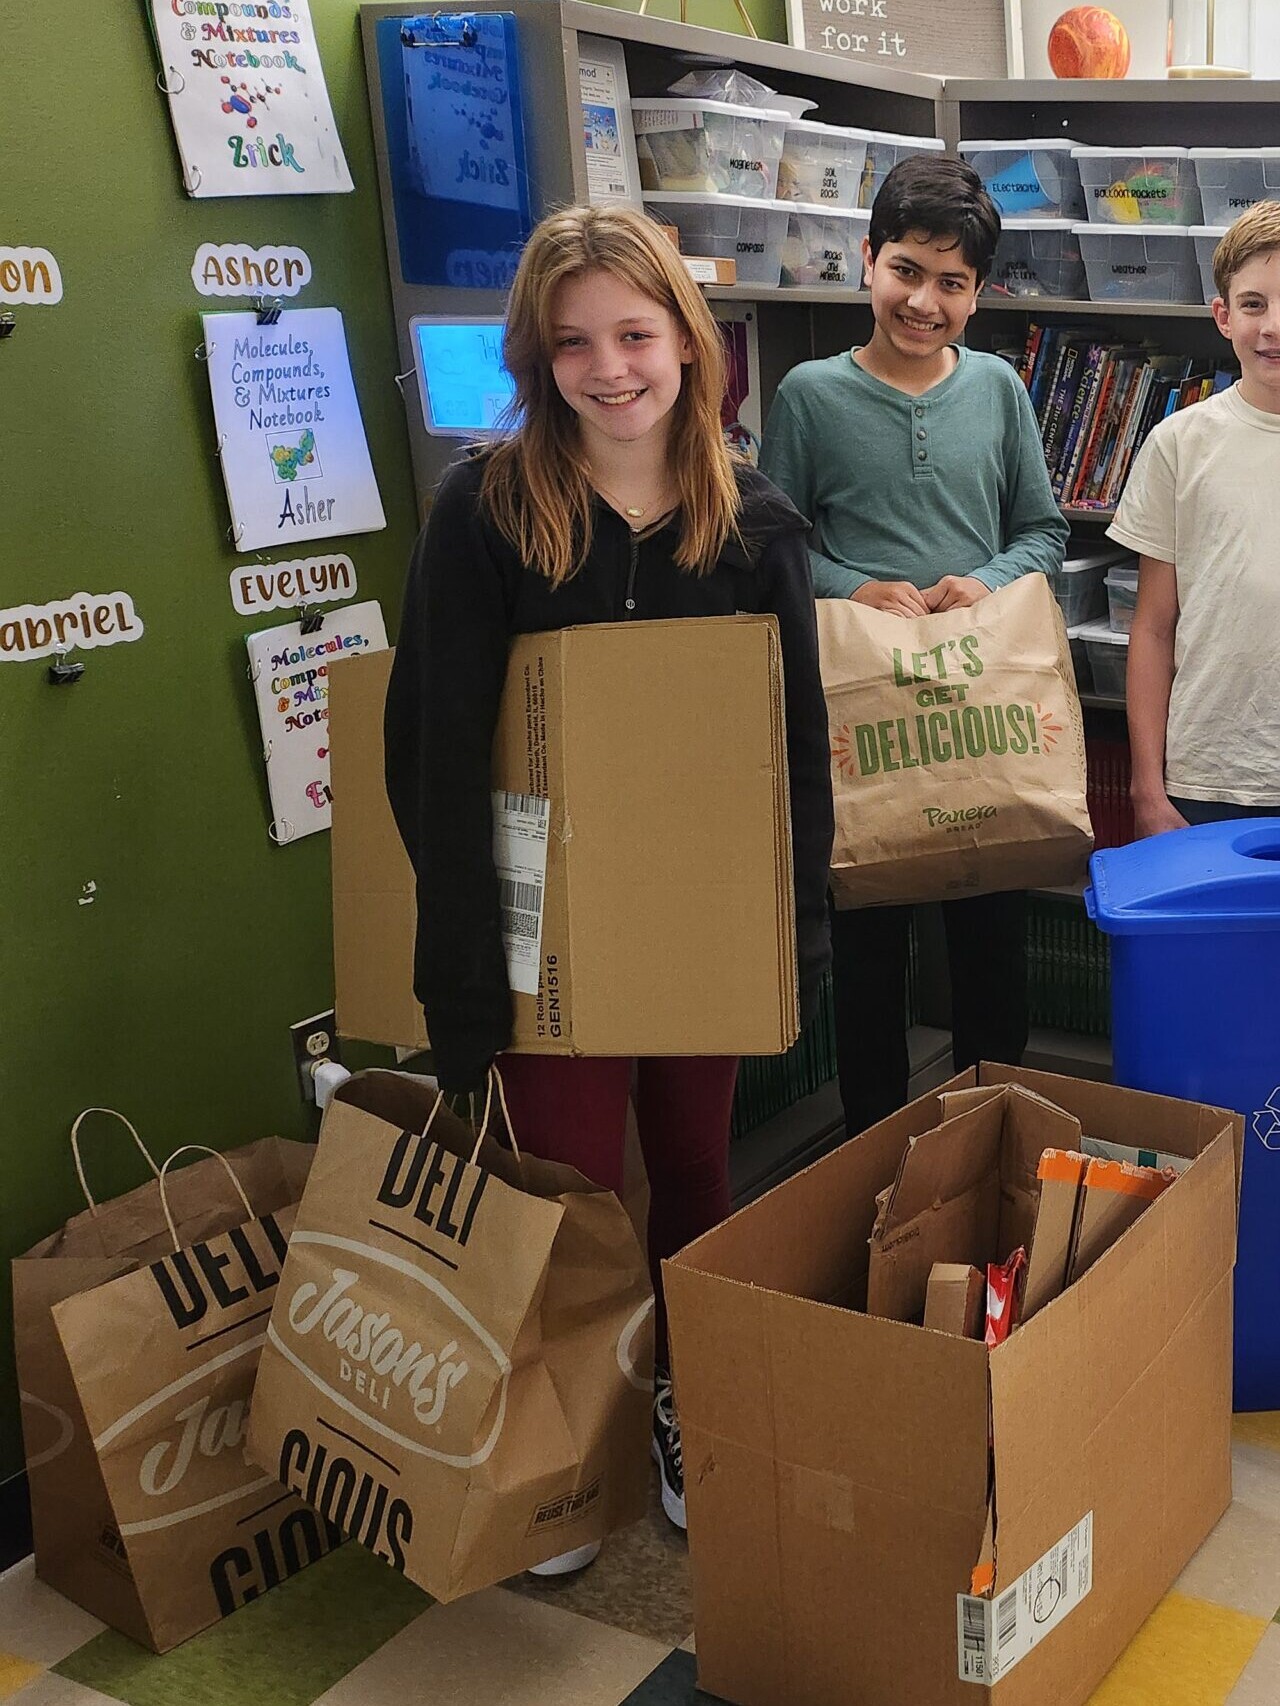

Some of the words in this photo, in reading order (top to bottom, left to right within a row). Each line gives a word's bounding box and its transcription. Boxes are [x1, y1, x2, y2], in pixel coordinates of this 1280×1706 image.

[171, 0, 299, 23] Compounds,
[820, 0, 887, 18] work
[201, 21, 300, 43] Mixtures
[821, 25, 869, 52] for
[877, 31, 906, 56] it
[191, 49, 306, 74] Notebook
[202, 255, 304, 287] Asher
[233, 334, 313, 361] Molecules,
[231, 355, 325, 388] Compounds,
[234, 387, 250, 407] &
[258, 382, 330, 405] Mixtures
[1057, 389, 1067, 404] THE
[1072, 366, 1094, 419] Science
[250, 402, 325, 431] Notebook
[1044, 423, 1057, 459] CENTURY
[277, 486, 335, 529] Asher
[240, 561, 350, 605] Evelyn
[271, 634, 369, 672] Molecules,
[893, 634, 984, 687] LET'S
[277, 697, 290, 712] &
[916, 683, 969, 708] GET
[855, 703, 1040, 776] DELICIOUS!
[922, 804, 998, 829] Panera
[946, 822, 983, 834] BREAD
[536, 992, 545, 1021] Rolls
[546, 955, 562, 1038] GEN1516
[537, 1025, 545, 1038] 12
[376, 1129, 489, 1248] DELI
[149, 1216, 291, 1330] DELI
[289, 1267, 468, 1425] Jason's
[339, 1364, 392, 1411] DELI
[279, 1429, 413, 1574] CIOUS
